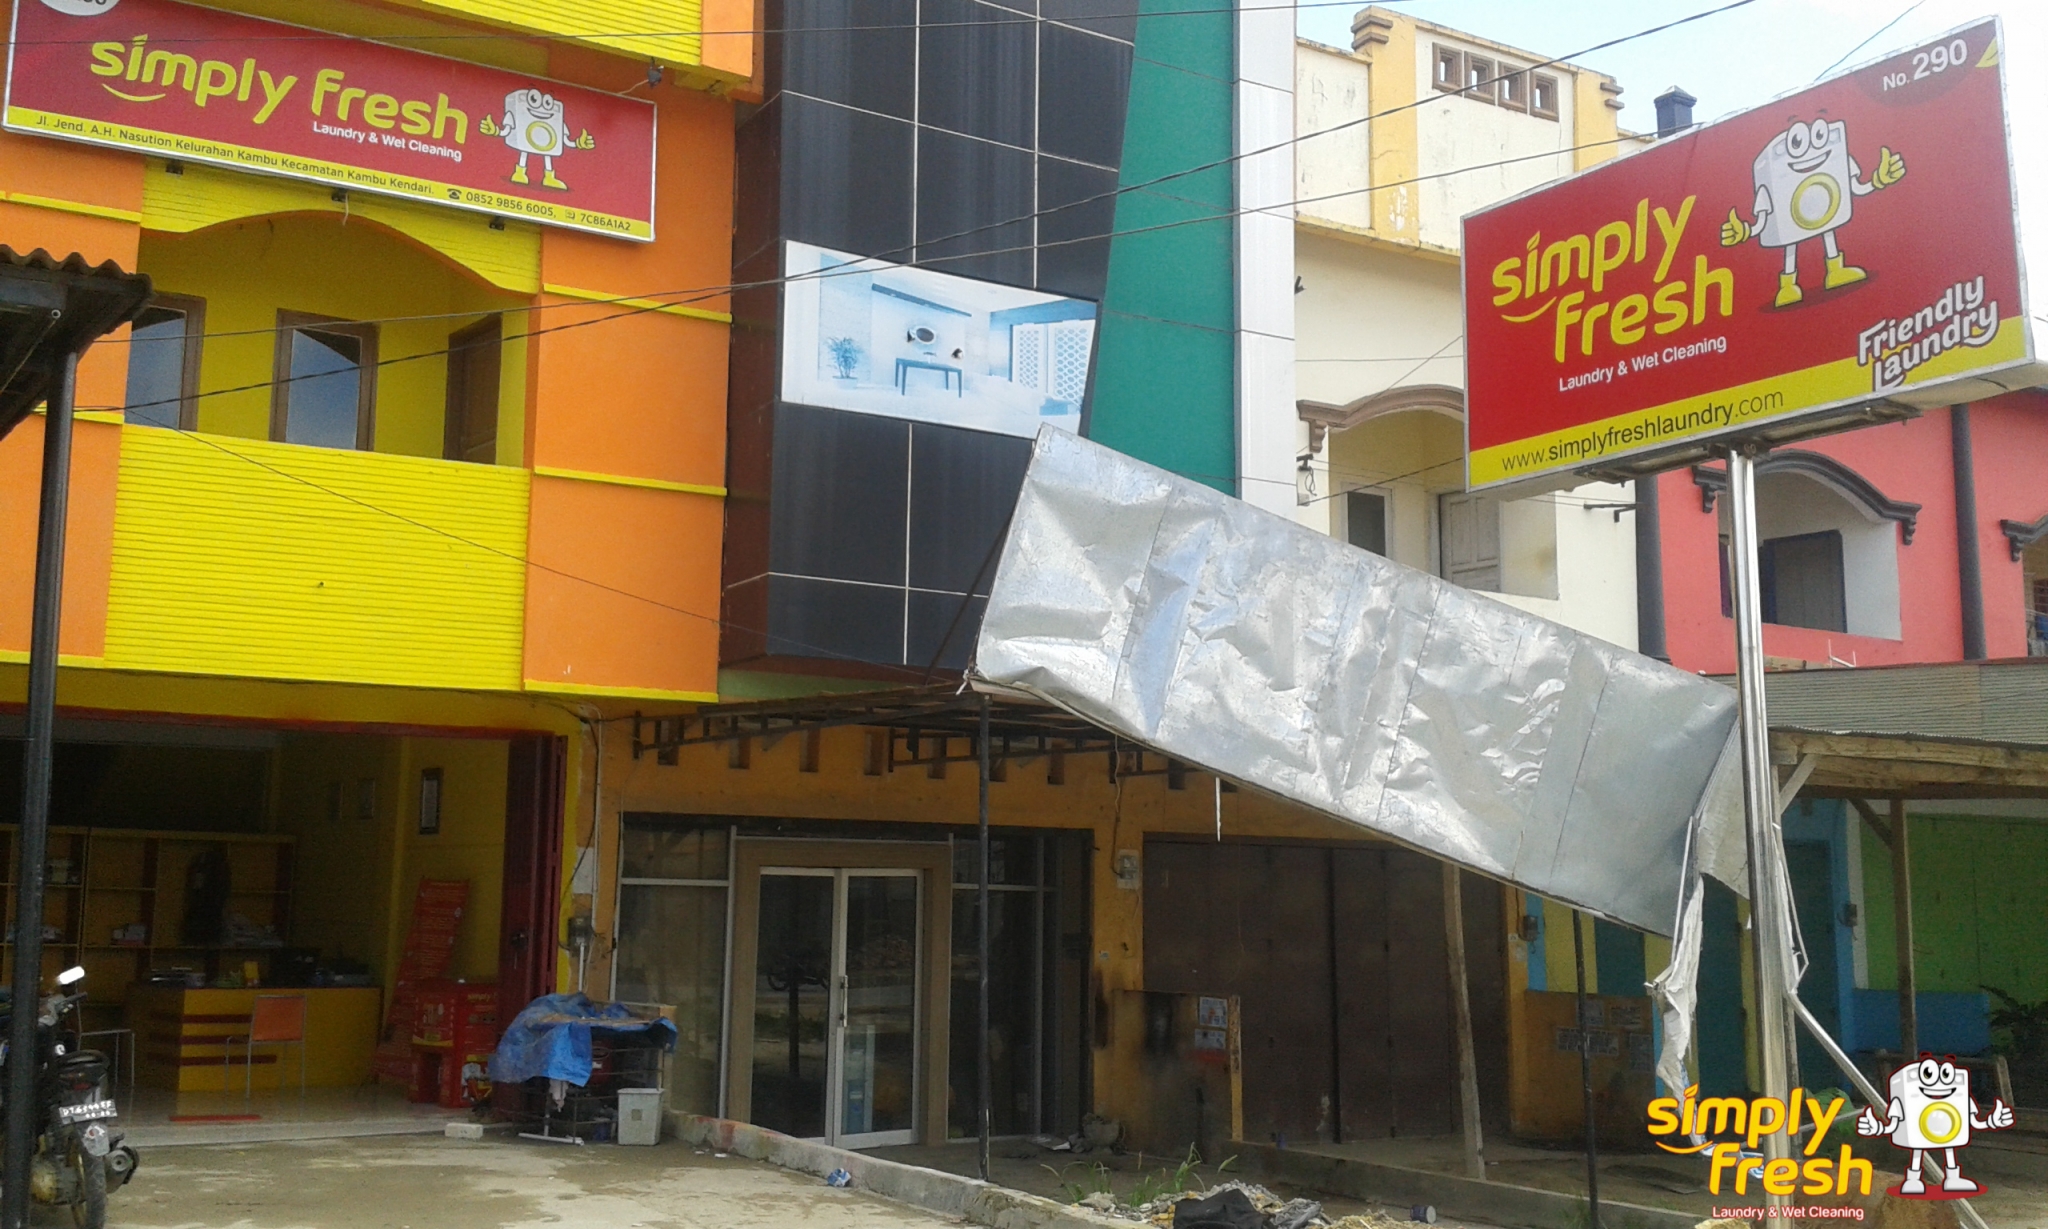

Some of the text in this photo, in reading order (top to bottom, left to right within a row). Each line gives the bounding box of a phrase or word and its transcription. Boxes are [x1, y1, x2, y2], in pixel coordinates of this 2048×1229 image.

[91, 34, 468, 144] simply fresh
[1883, 38, 1968, 93] No. 290
[36, 115, 49, 127] Jl.
[53, 118, 86, 133] Jend.
[90, 124, 115, 138] A.H.
[119, 129, 172, 148] Nasution
[176, 139, 234, 158] Kelurahan
[238, 150, 277, 166] Kambu
[281, 158, 344, 178] Kecamatan
[347, 170, 386, 186] Kambu
[390, 178, 434, 195] Kendari.
[466, 191, 493, 205] 0852
[496, 197, 523, 211] 9856
[313, 121, 462, 162] Laundry & Wet Cleaning
[1492, 195, 1697, 306] simply
[1555, 254, 1733, 363] fresh
[1858, 275, 1985, 366] Friendly
[1559, 336, 1728, 392] Laundry & Wet Cleaning
[1502, 389, 1784, 473] www.simplyfreshlaundry.com
